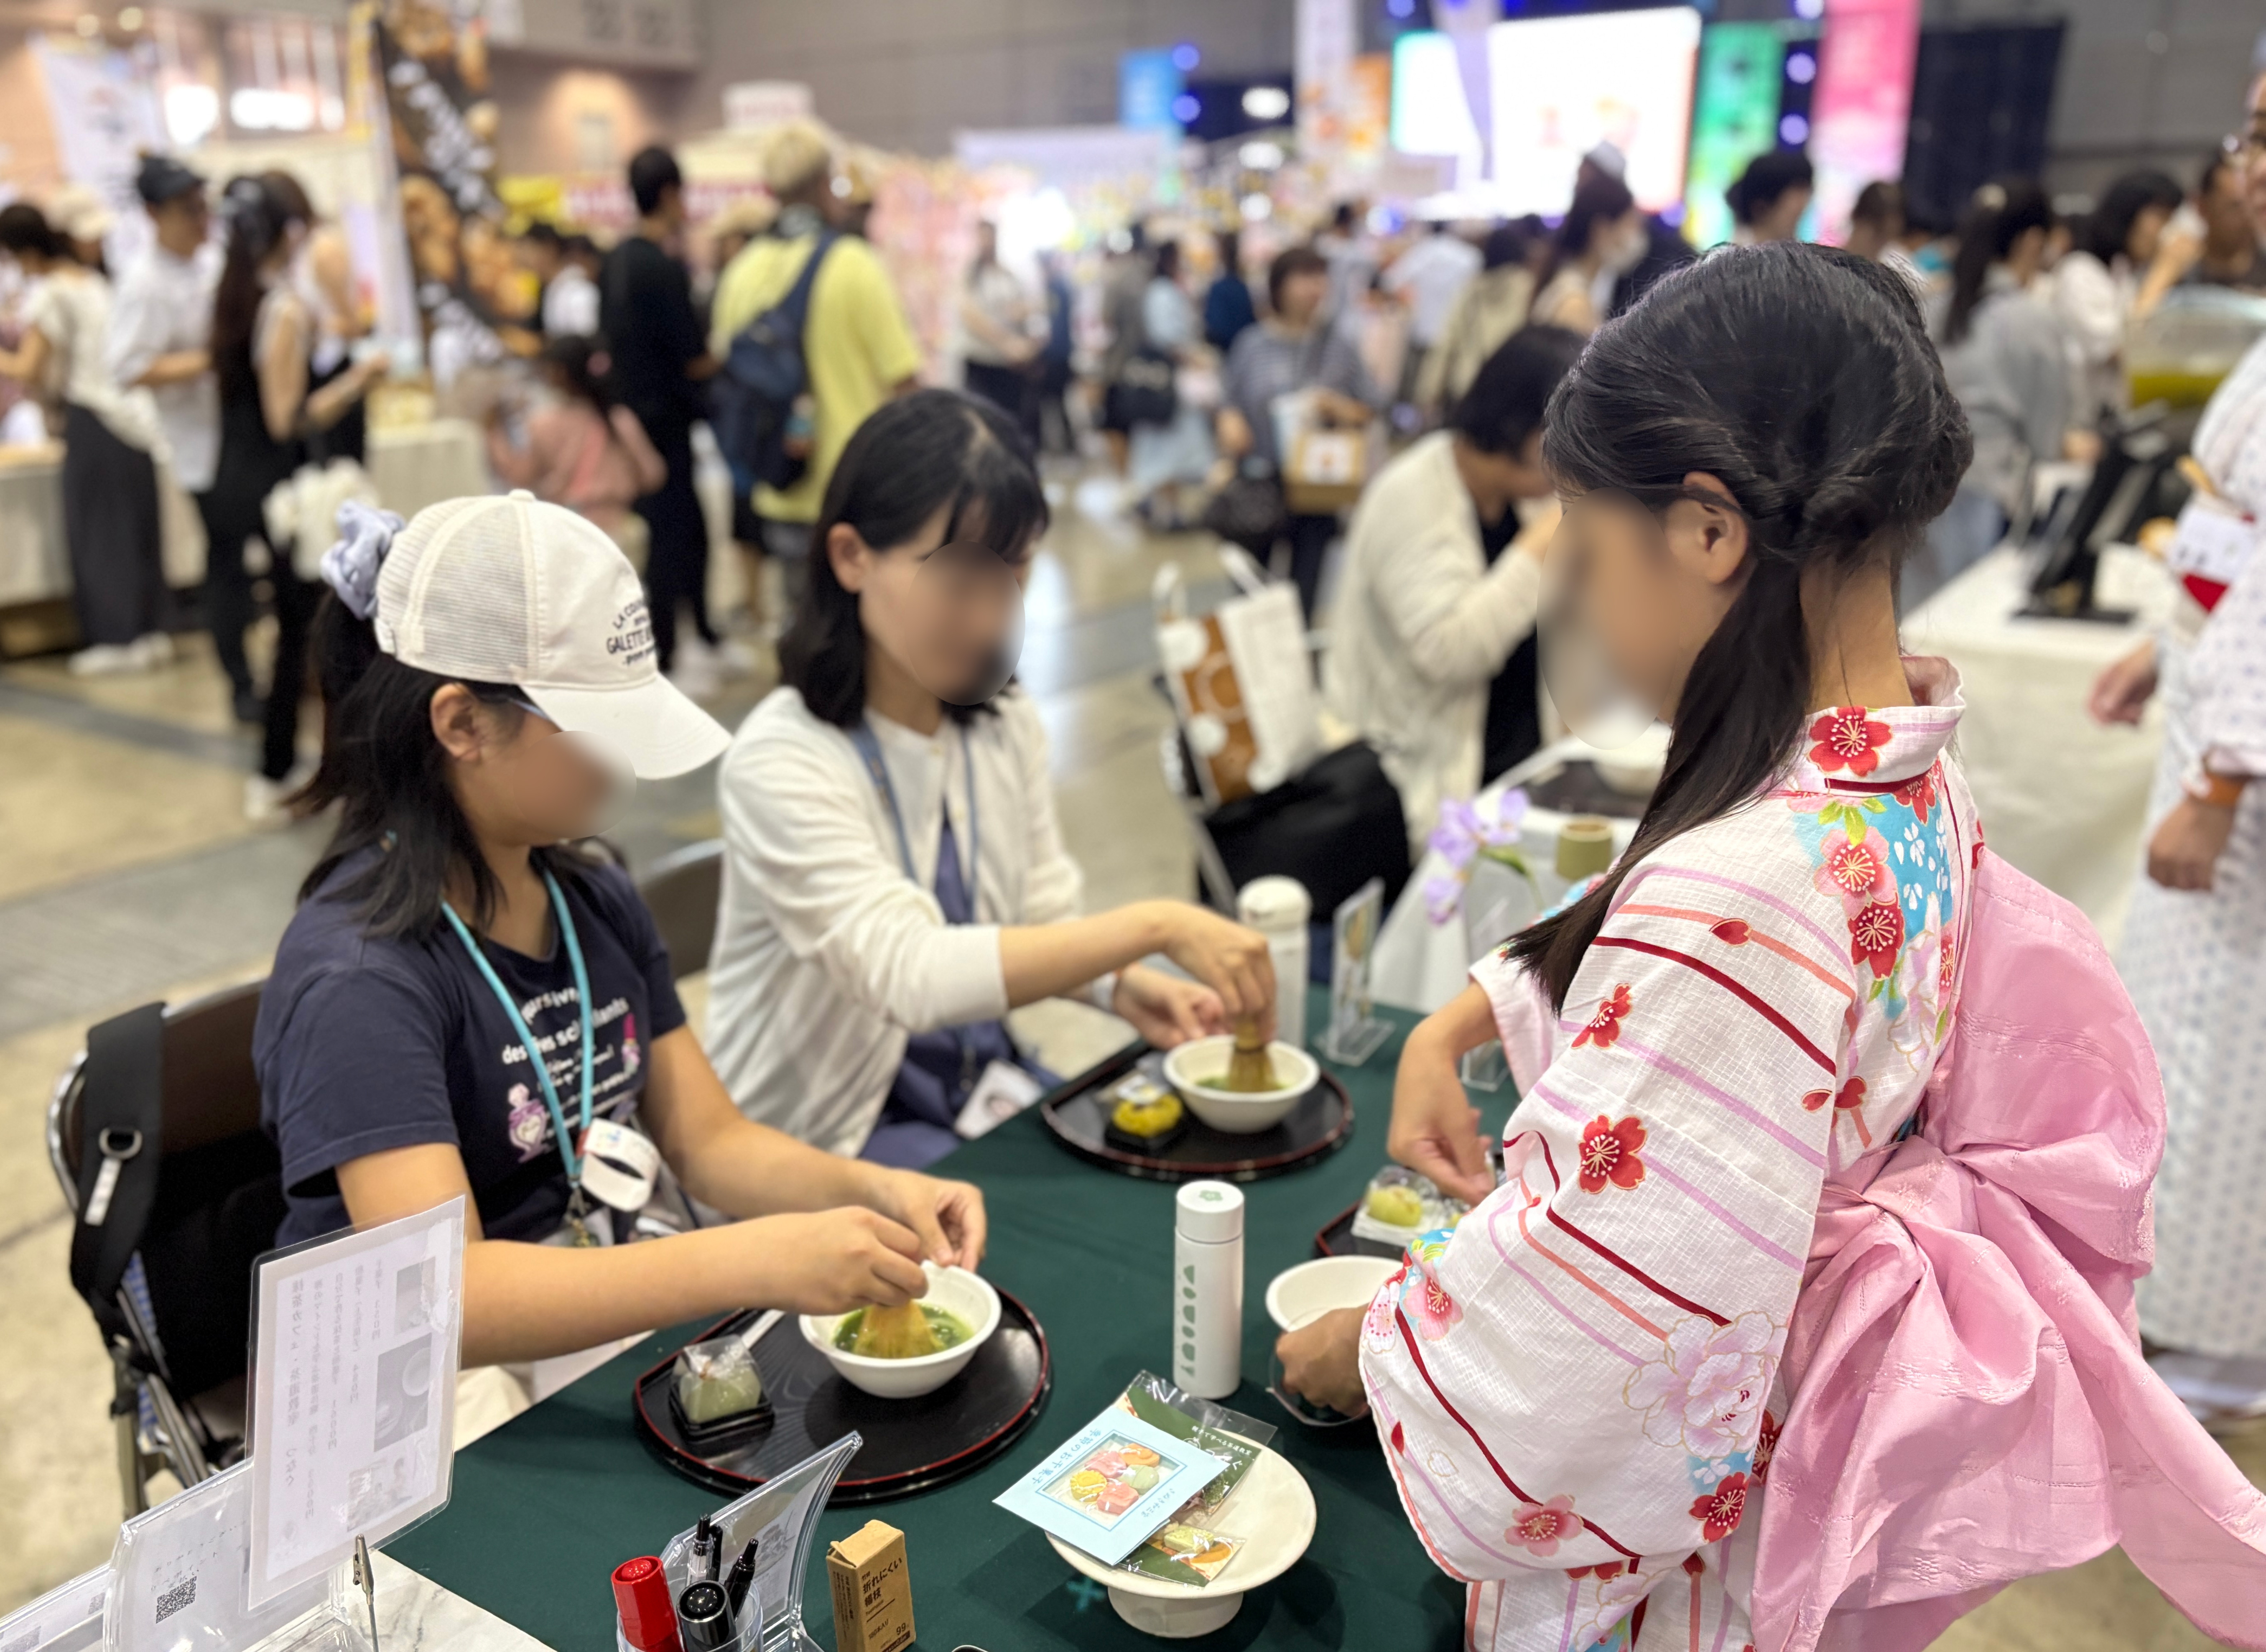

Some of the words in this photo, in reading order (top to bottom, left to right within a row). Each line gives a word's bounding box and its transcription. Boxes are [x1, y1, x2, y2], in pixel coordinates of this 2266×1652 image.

[863, 1557, 902, 1594] 折れにくい
[896, 1622, 907, 1636] 99
